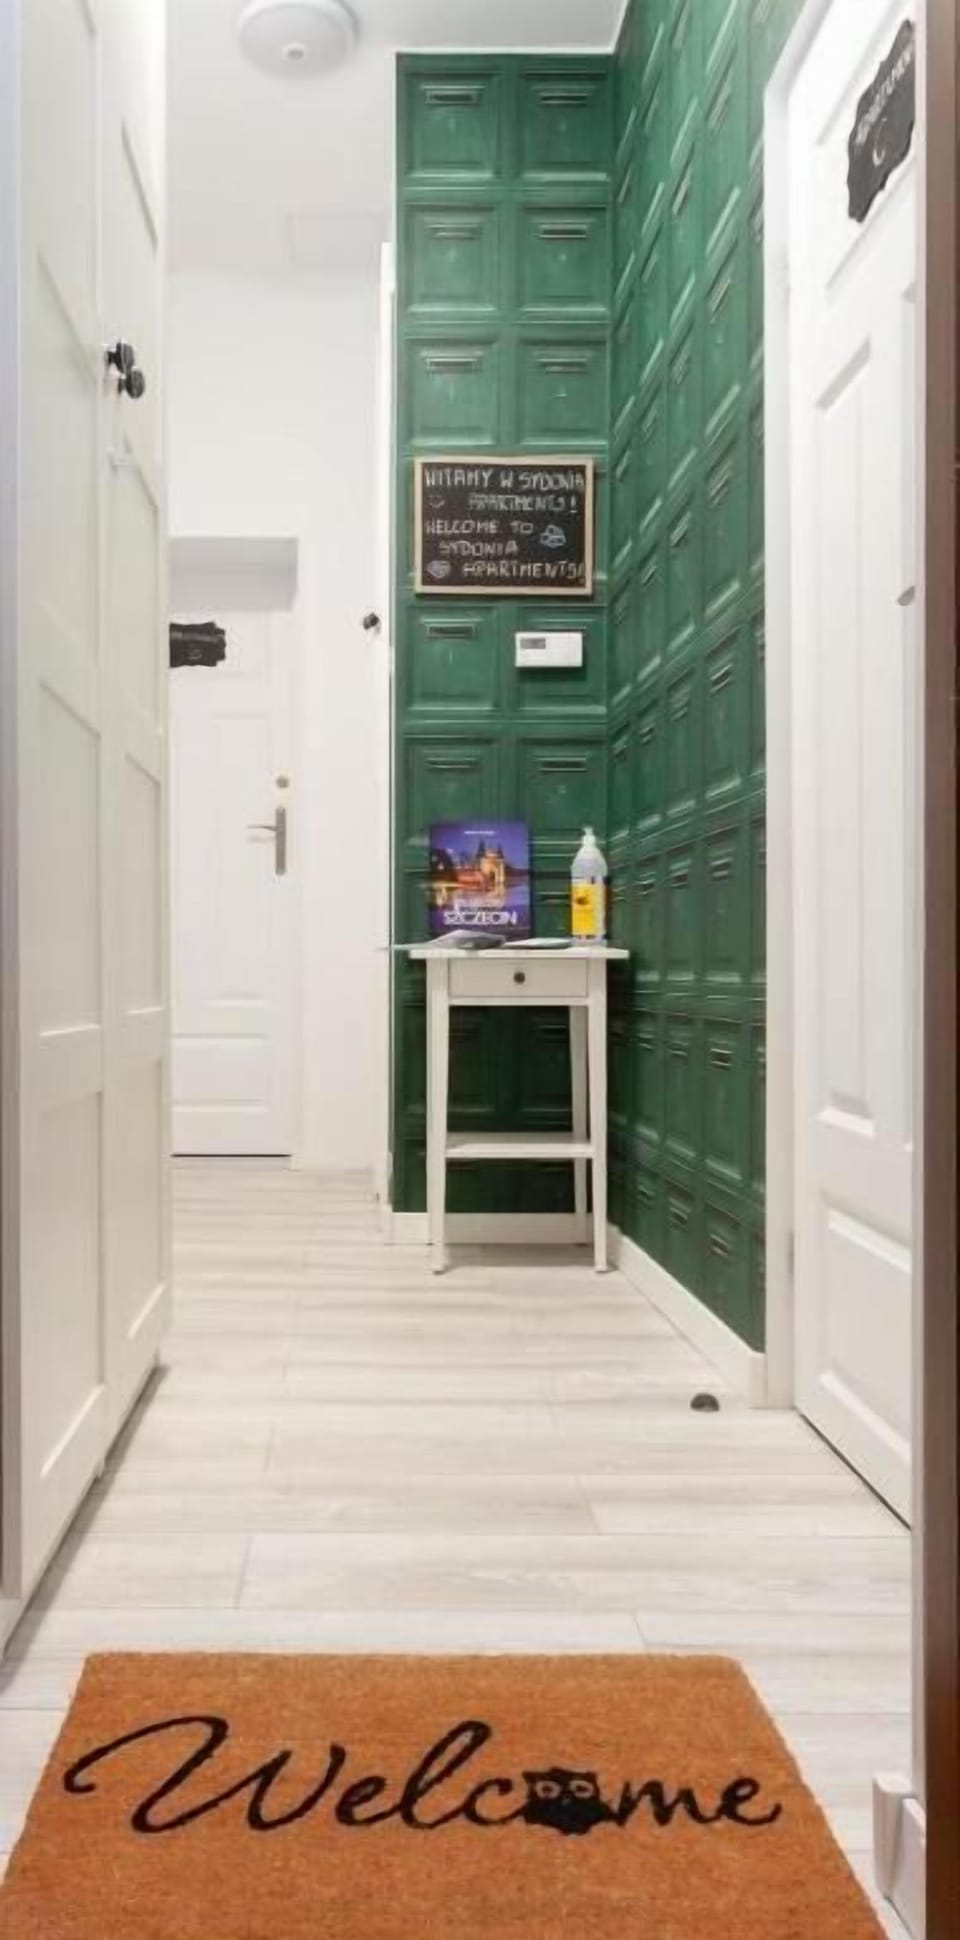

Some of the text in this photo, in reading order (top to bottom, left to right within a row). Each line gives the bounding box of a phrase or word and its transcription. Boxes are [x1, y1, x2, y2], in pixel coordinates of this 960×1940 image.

[426, 519, 534, 535] WELCOME TO
[438, 540, 519, 556] SYDONIA
